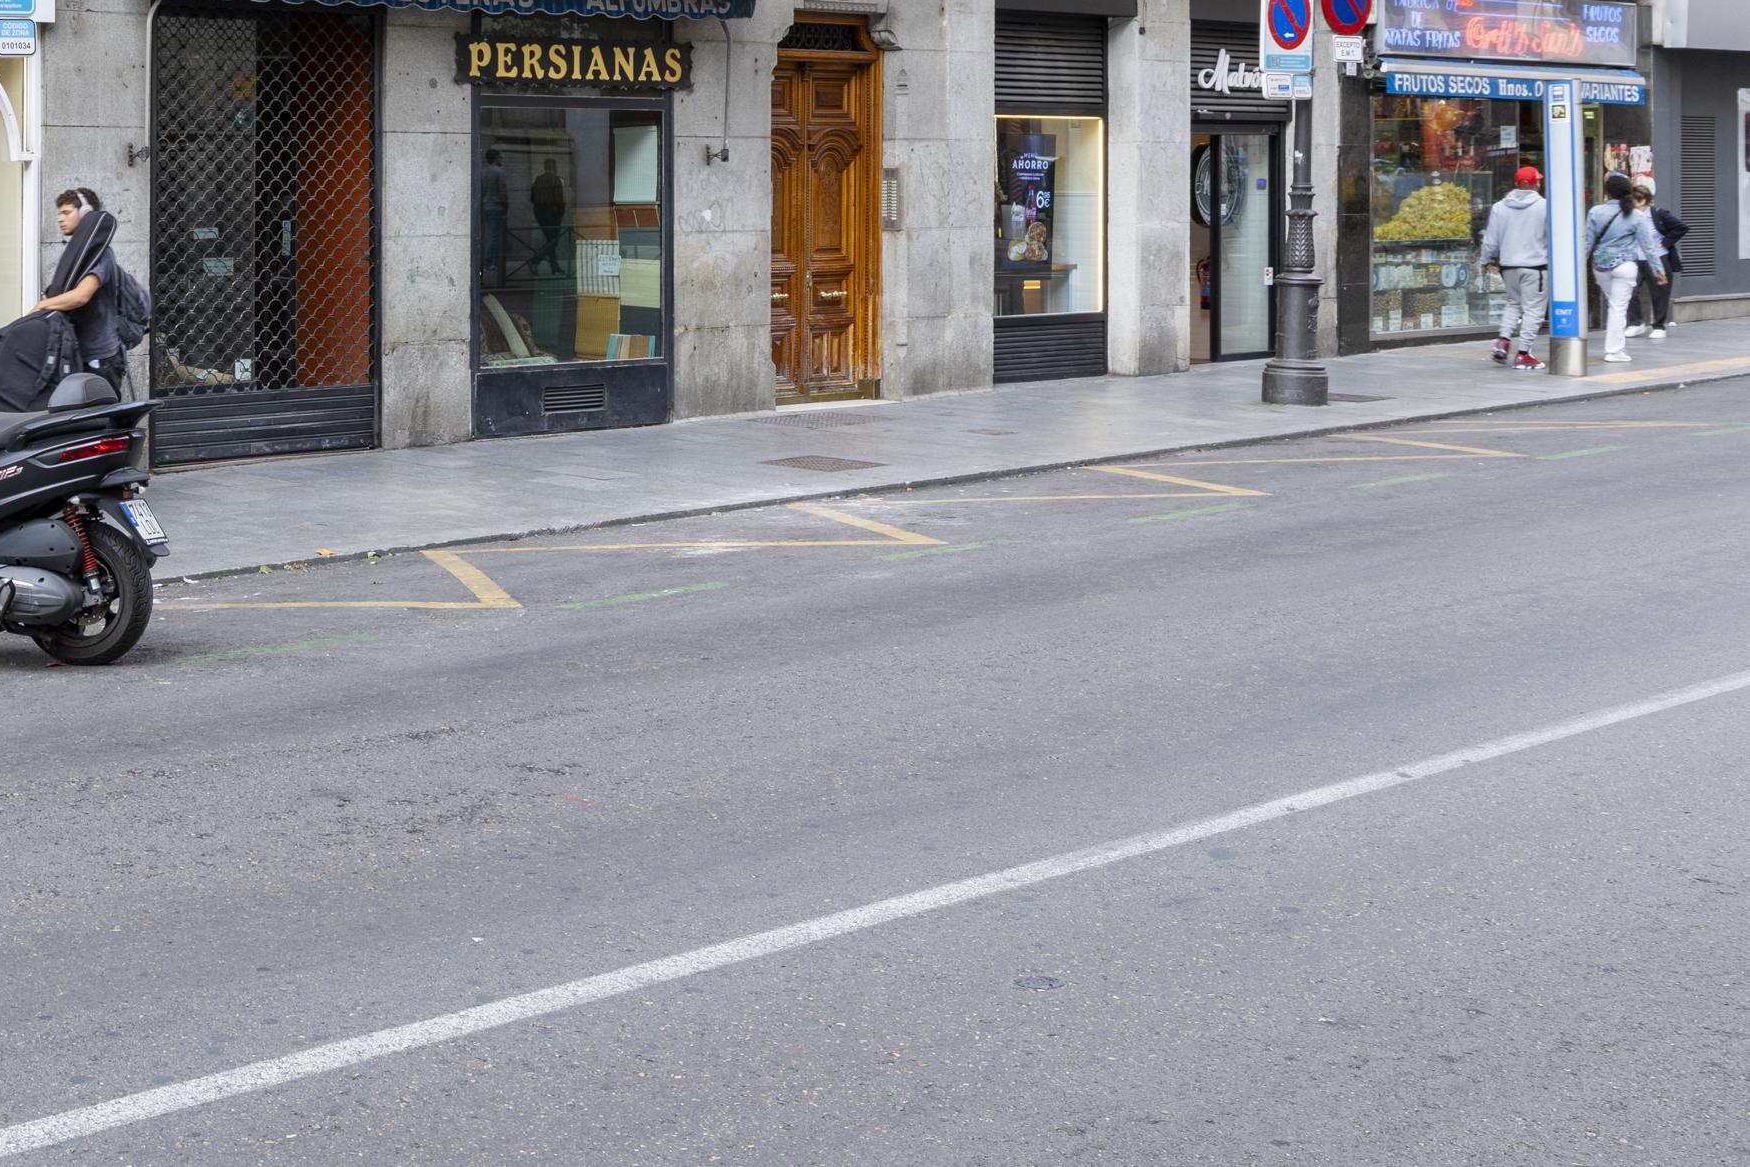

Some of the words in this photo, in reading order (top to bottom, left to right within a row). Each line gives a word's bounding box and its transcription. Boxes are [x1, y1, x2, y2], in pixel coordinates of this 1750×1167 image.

[469, 39, 683, 83] PERSIANAS
[1394, 73, 1446, 94] FRUTOS
[1448, 75, 1491, 96] SECOS
[1498, 78, 1533, 98] Hnos.
[1012, 159, 1049, 170] AHORRO
